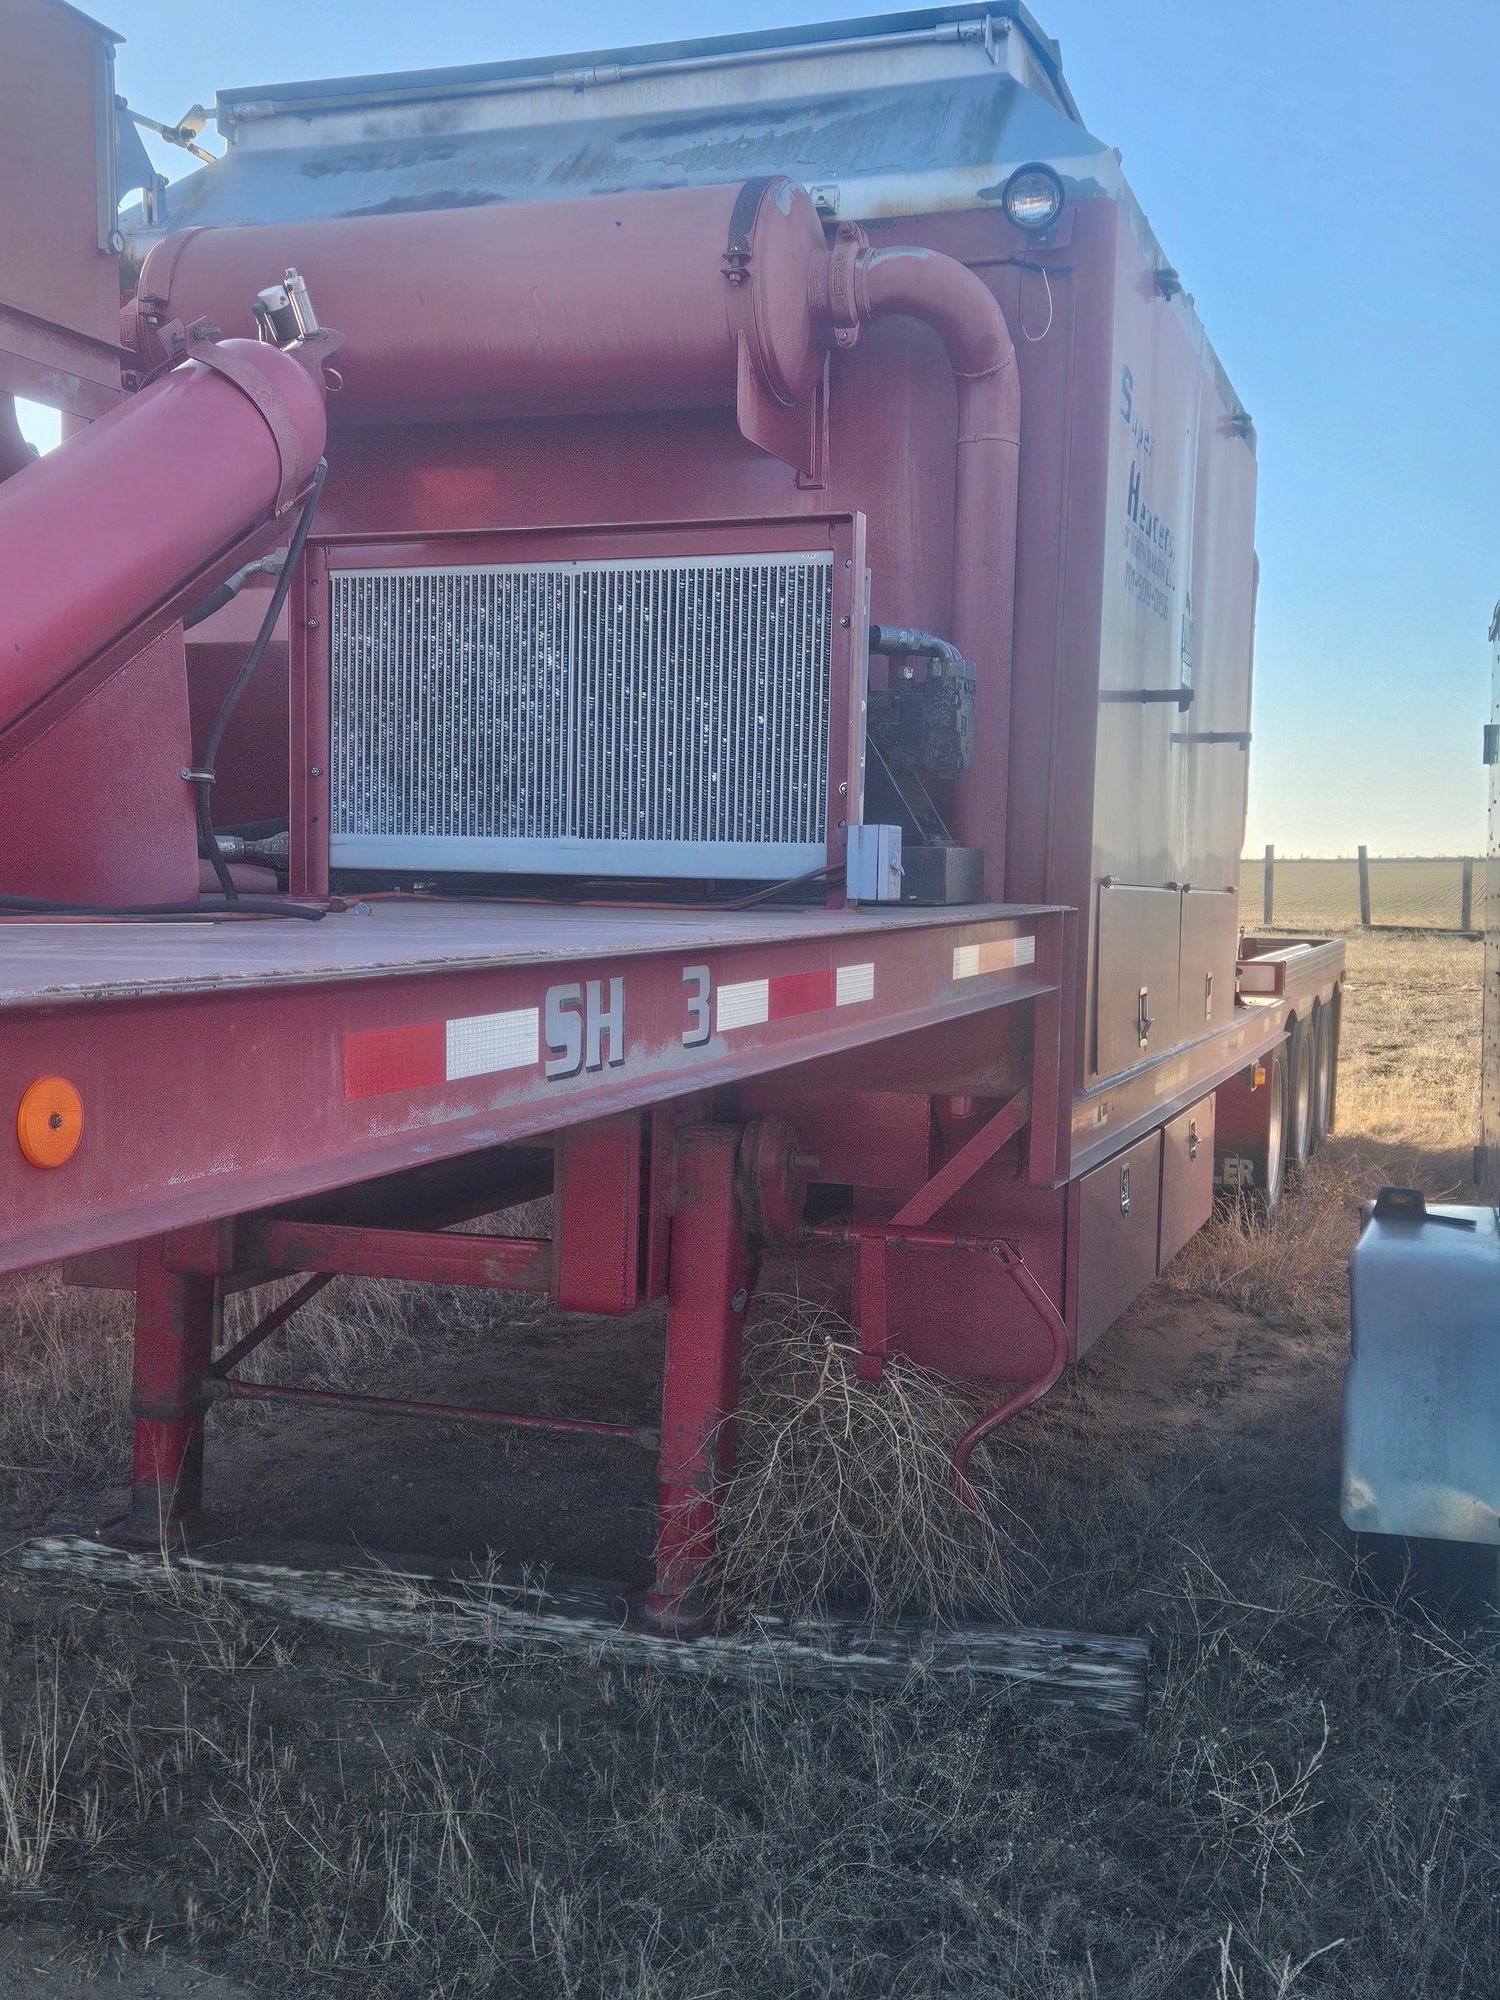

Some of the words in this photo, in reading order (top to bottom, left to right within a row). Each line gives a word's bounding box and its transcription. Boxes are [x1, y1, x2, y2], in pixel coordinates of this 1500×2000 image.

[1120, 363, 1155, 457] Super
[545, 976, 626, 1083] SH
[682, 965, 712, 1050] 3
